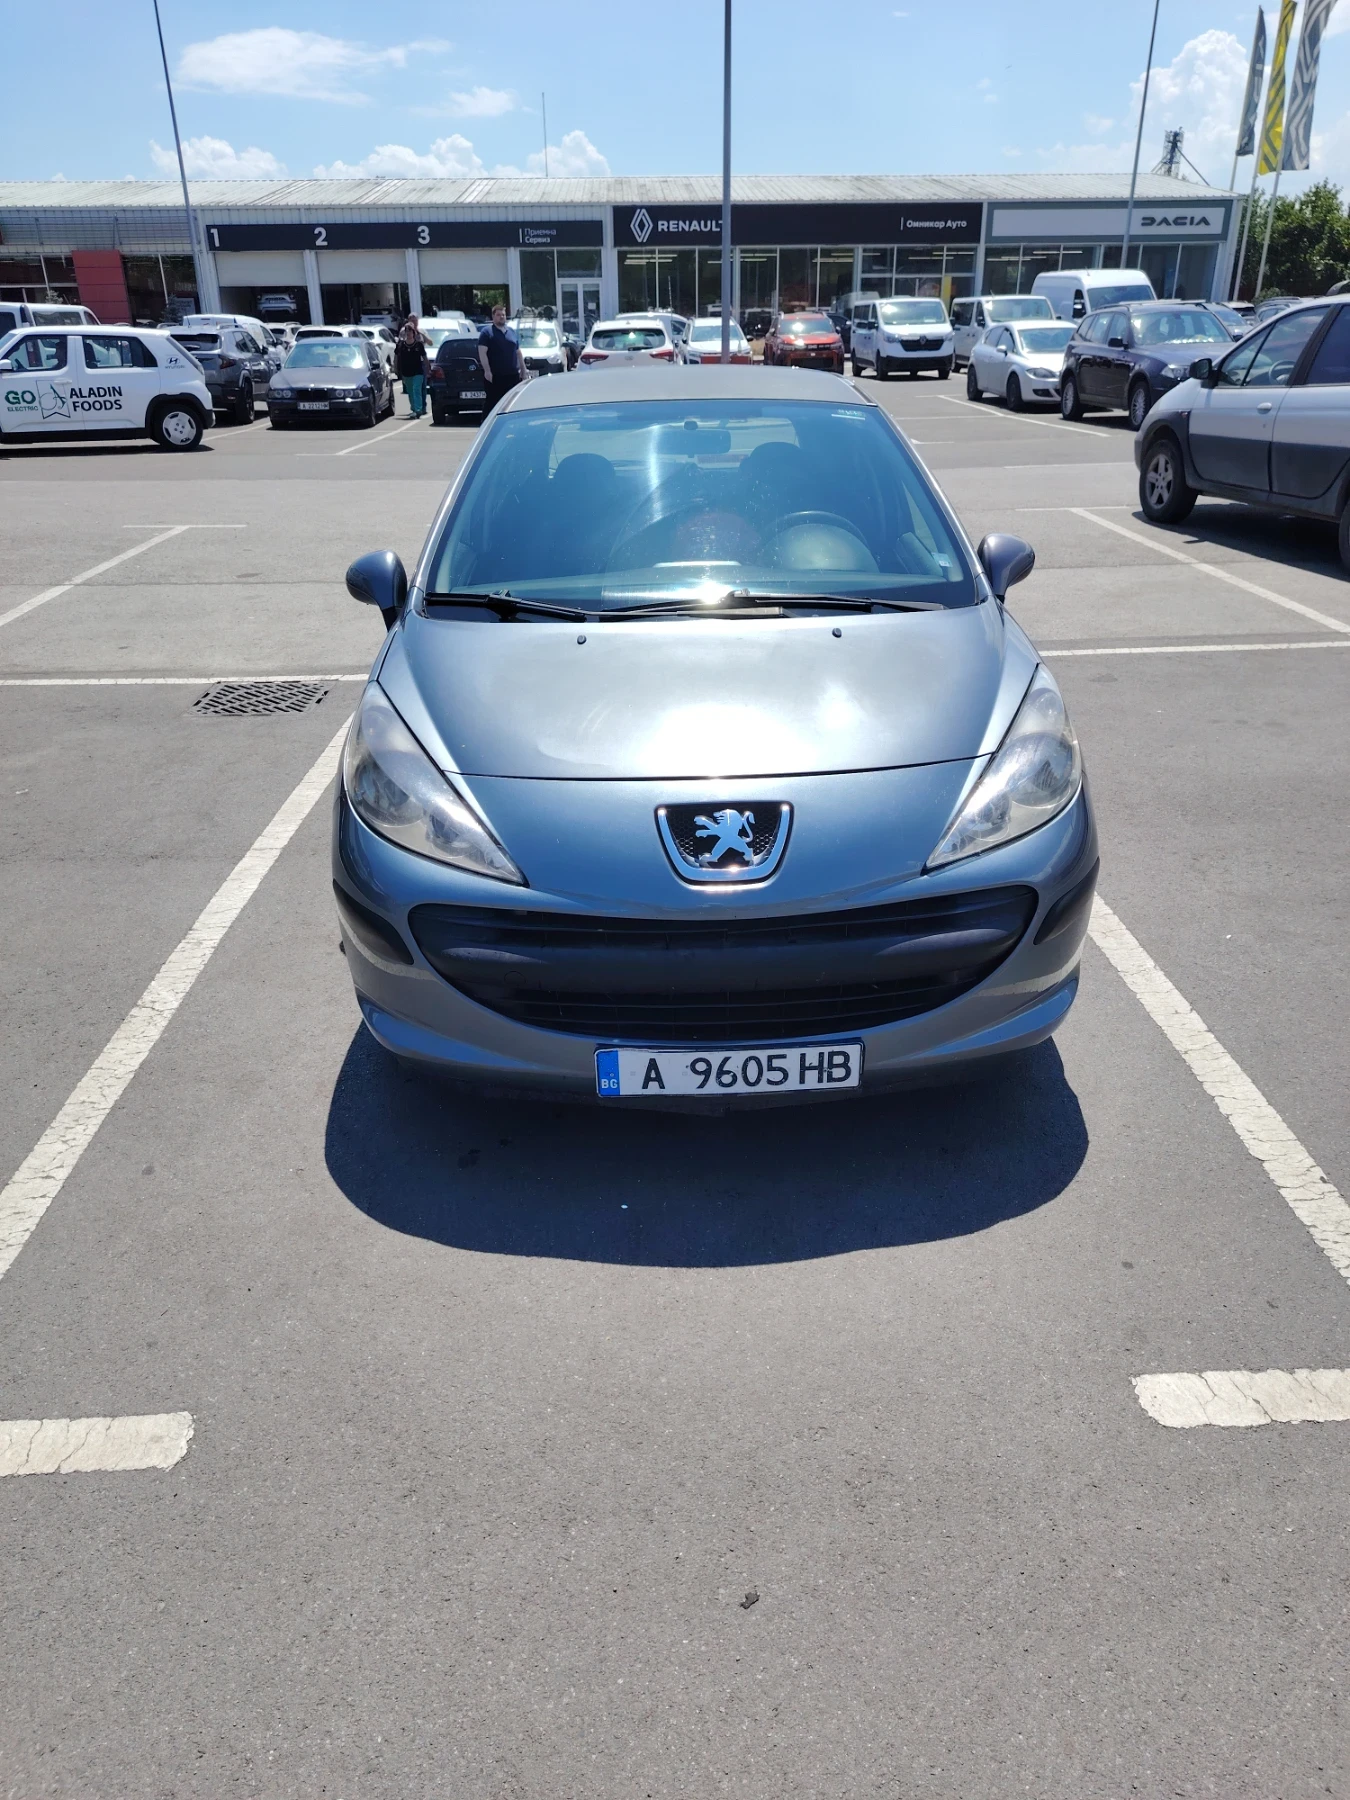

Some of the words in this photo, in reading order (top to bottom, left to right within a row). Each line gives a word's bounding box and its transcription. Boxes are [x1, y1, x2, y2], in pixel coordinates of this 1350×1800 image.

[906, 218, 944, 230] Омникар
[945, 219, 967, 231] Ауто
[1141, 216, 1210, 227] DACIA
[210, 228, 220, 247] 1
[313, 227, 328, 246] 2
[417, 225, 430, 245] 3
[524, 228, 556, 238] Приемна
[524, 236, 551, 245] Сервиз
[4, 390, 36, 405] GO
[69, 386, 123, 399] ALADIN
[72, 399, 122, 412] FOODS
[641, 1057, 666, 1090] A
[689, 1053, 790, 1089] 9605
[799, 1050, 852, 1084] HB
[601, 1079, 618, 1089] BG
